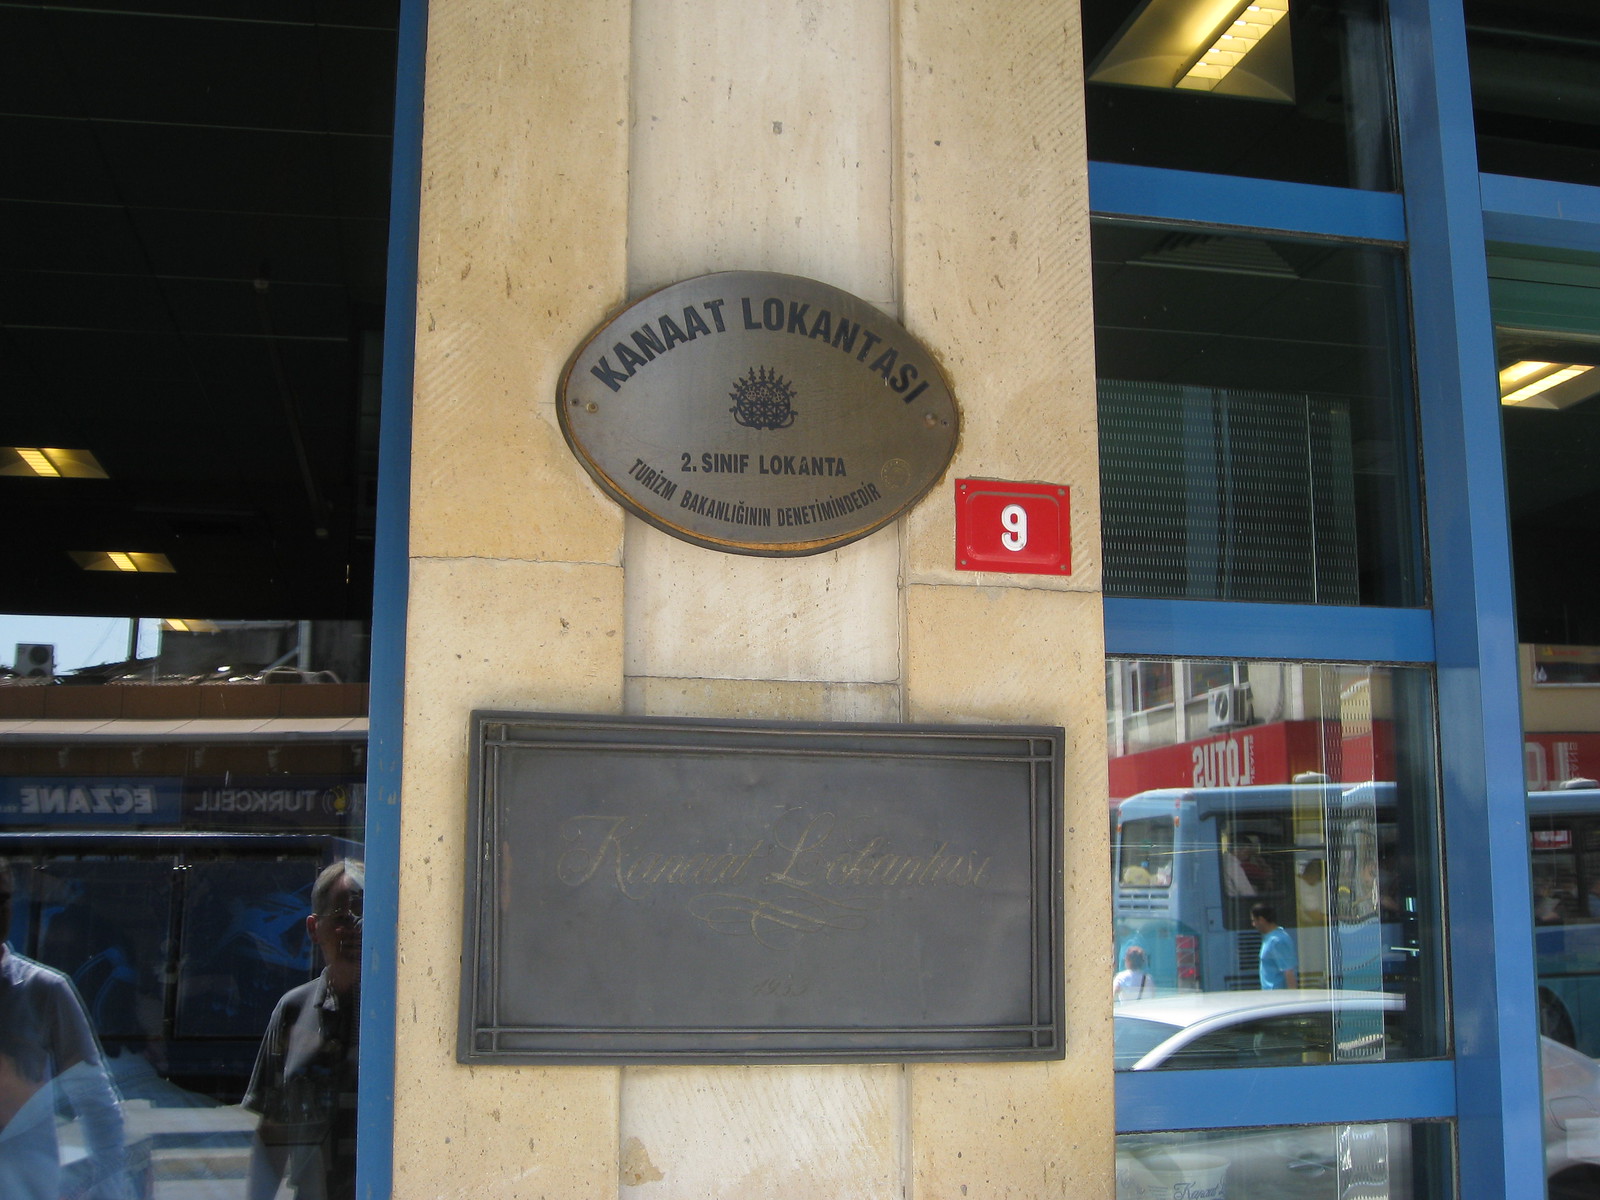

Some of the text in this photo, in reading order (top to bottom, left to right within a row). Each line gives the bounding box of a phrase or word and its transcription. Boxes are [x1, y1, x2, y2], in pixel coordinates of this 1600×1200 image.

[590, 297, 930, 405] KANAAT LOKANTASI
[628, 458, 882, 527] TURİZM BAKANLIĞININ DENETİMİNDEDİR
[681, 453, 847, 477] 2. SINIF LOKANTA
[1001, 503, 1028, 552] 9
